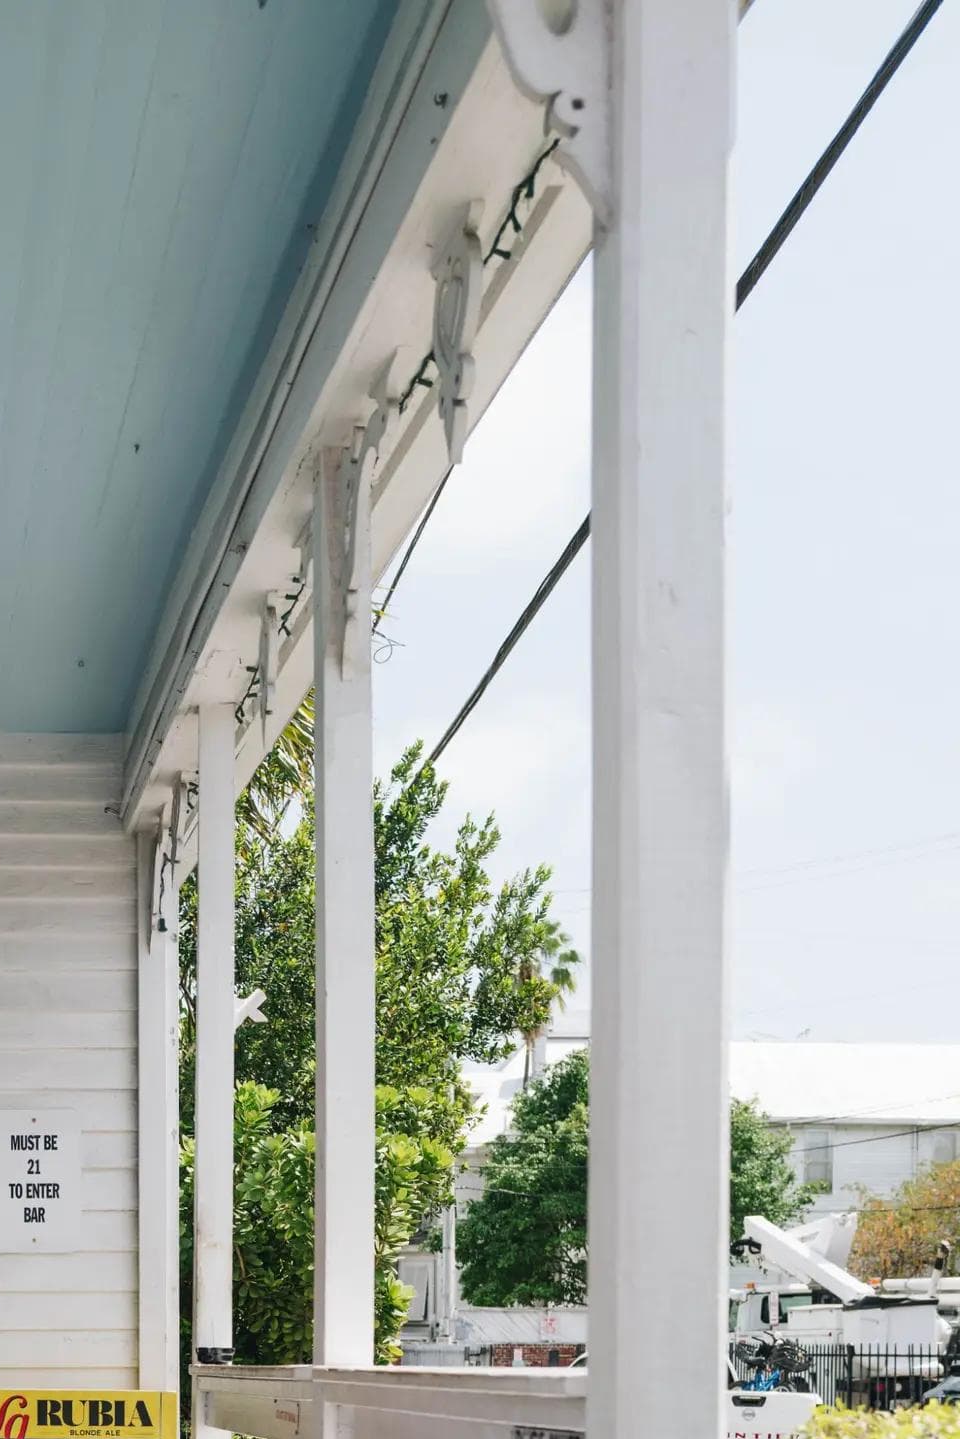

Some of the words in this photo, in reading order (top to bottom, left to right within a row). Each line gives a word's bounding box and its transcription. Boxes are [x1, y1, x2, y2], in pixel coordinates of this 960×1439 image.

[11, 1135, 41, 1150] MUST
[44, 1135, 58, 1150] BE
[27, 1159, 41, 1174] 21
[9, 1184, 23, 1199] TO
[26, 1184, 60, 1199] ENTER
[24, 1207, 45, 1223] BAR
[37, 1400, 153, 1427] RUBIA
